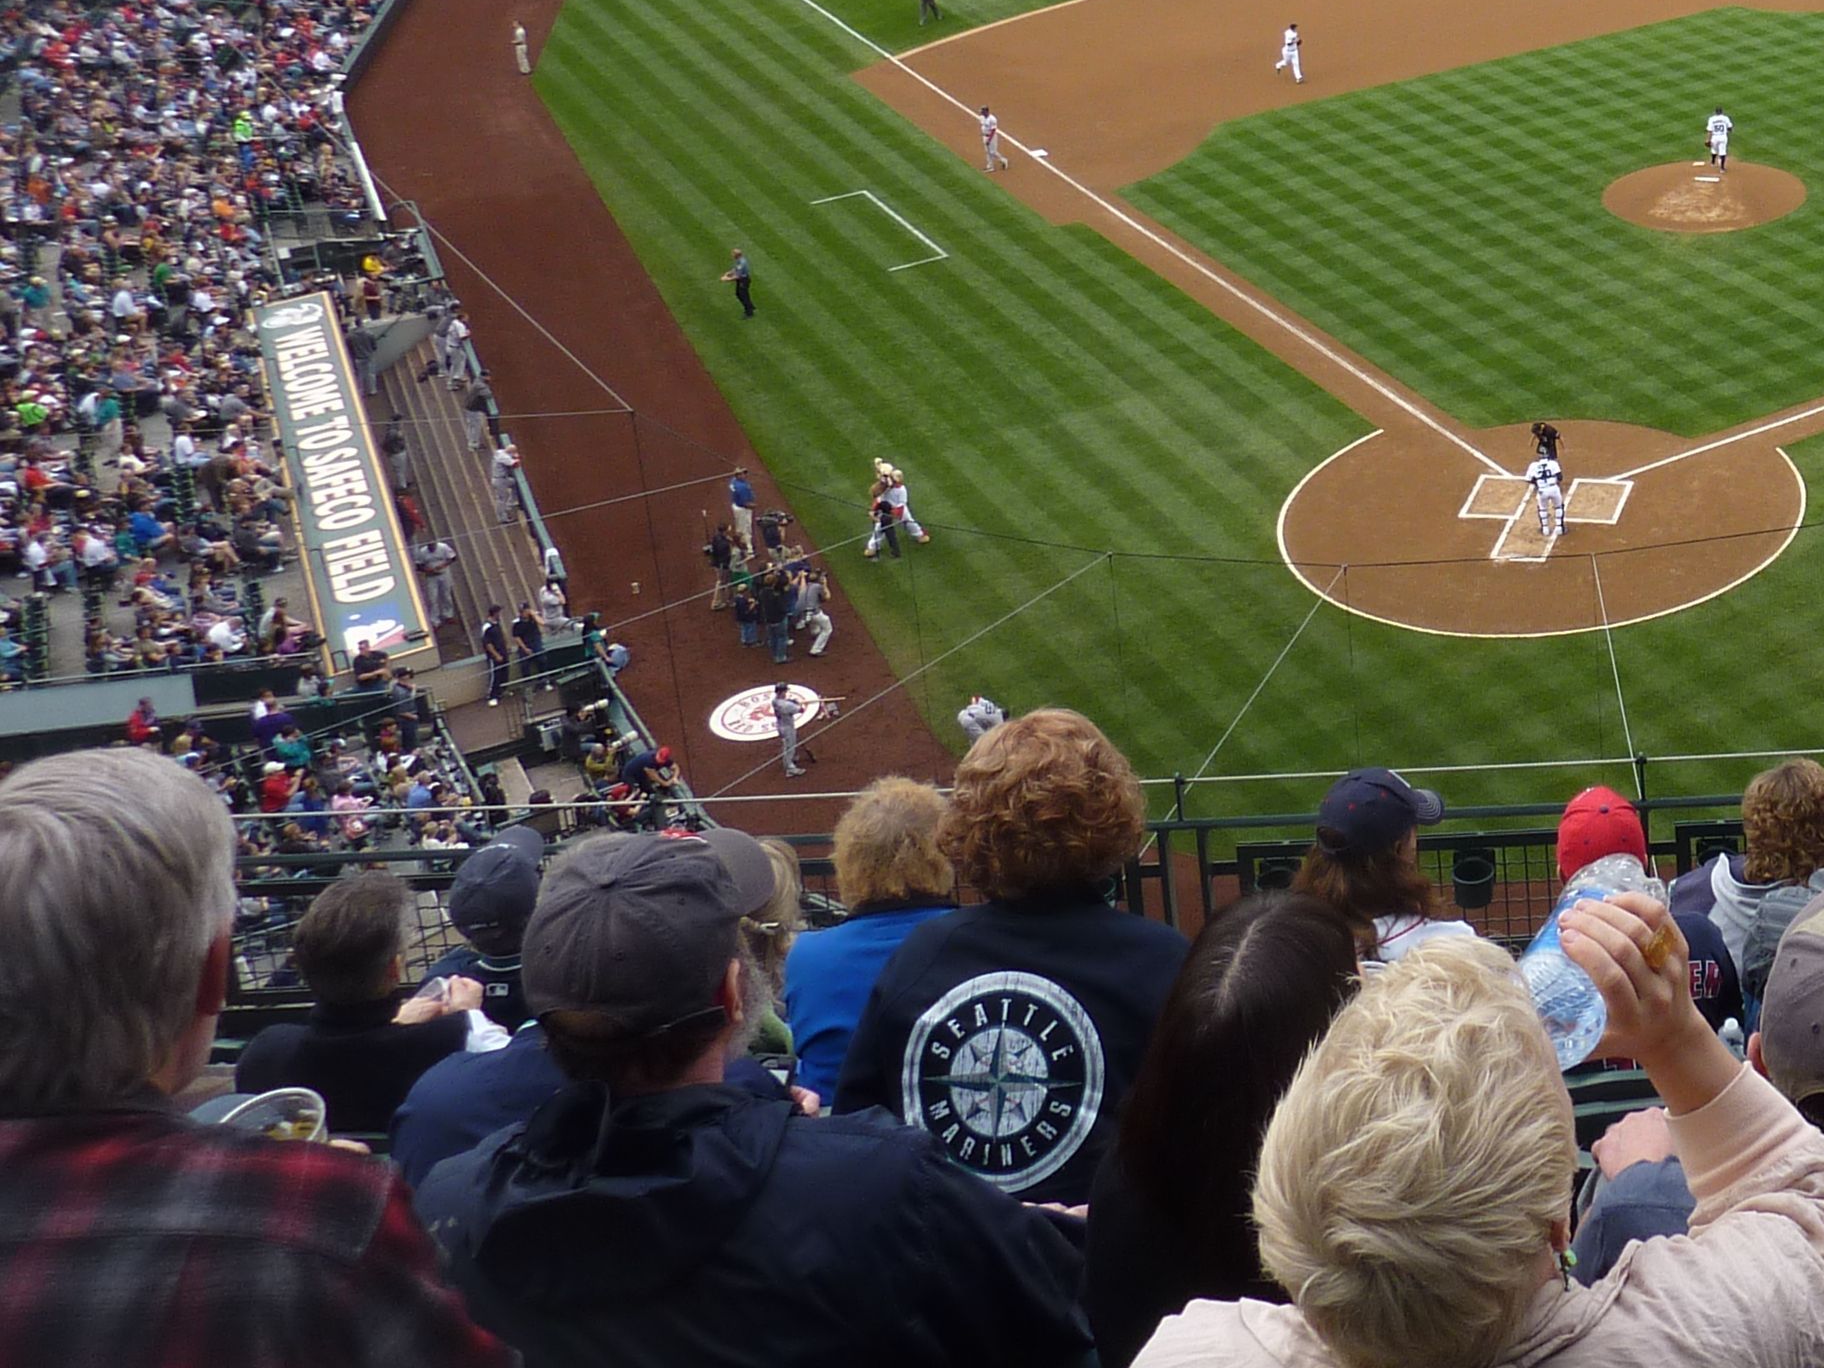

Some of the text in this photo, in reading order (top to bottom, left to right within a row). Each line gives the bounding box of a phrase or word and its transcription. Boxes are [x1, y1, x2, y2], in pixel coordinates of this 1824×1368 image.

[275, 325, 396, 604] WELCOME TO SAFECO FIELD
[931, 998, 1074, 1062] SEATTLE
[929, 1100, 1072, 1167] MARINERS
